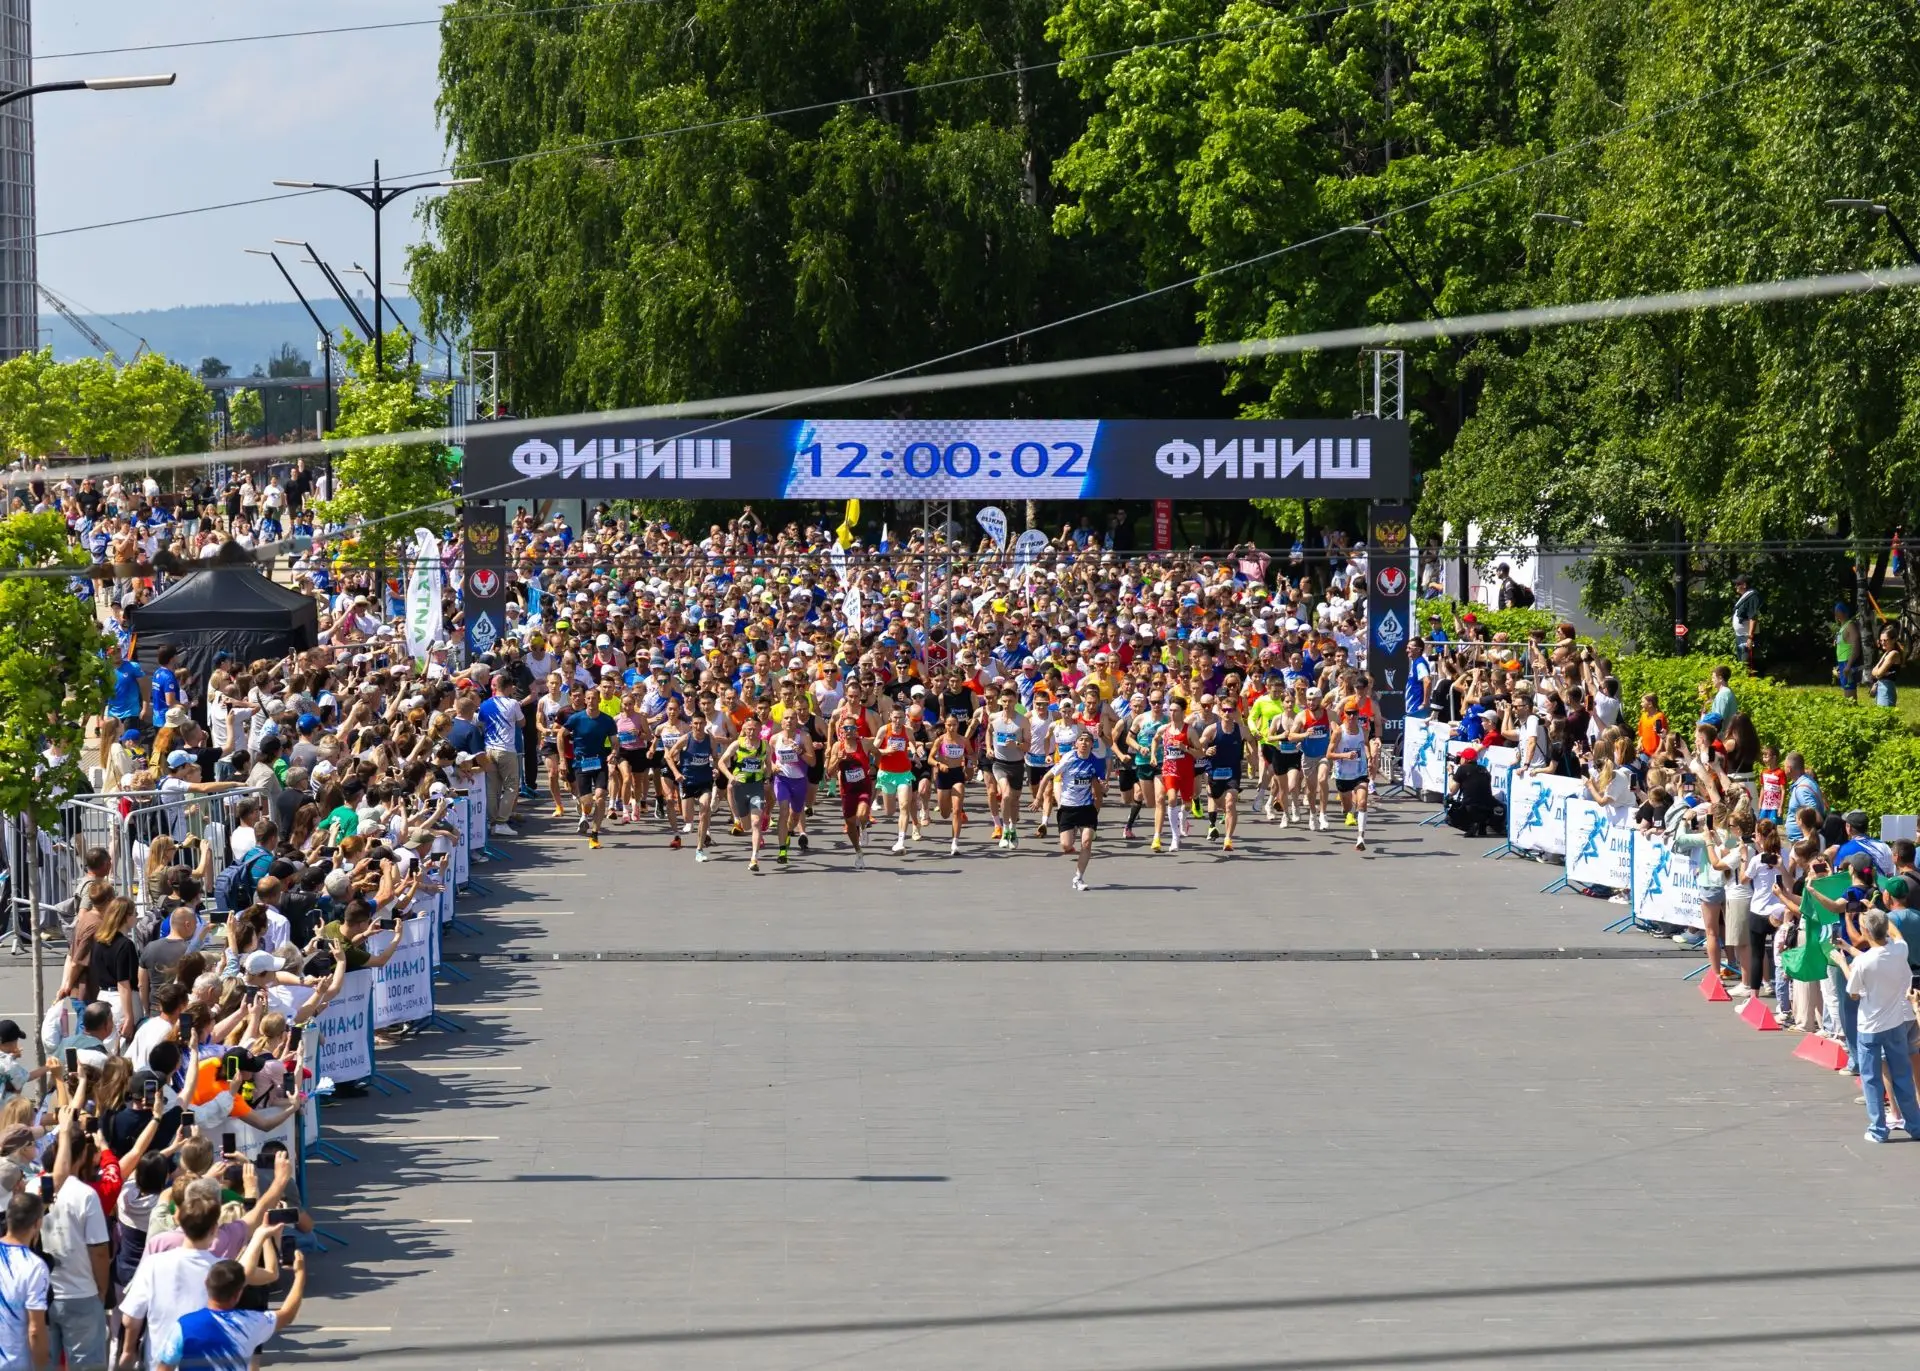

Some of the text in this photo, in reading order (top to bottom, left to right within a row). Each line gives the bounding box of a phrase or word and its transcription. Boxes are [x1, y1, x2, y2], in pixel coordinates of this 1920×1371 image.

[512, 438, 731, 480] ФИНИШ
[800, 441, 1087, 478] 12:00:02
[1155, 438, 1370, 479] ФИНИШ
[377, 956, 425, 983] ДИНАМО
[388, 984, 415, 998] 100 лет
[320, 1011, 364, 1038] ИНАМО
[322, 1041, 354, 1057] 100 лет
